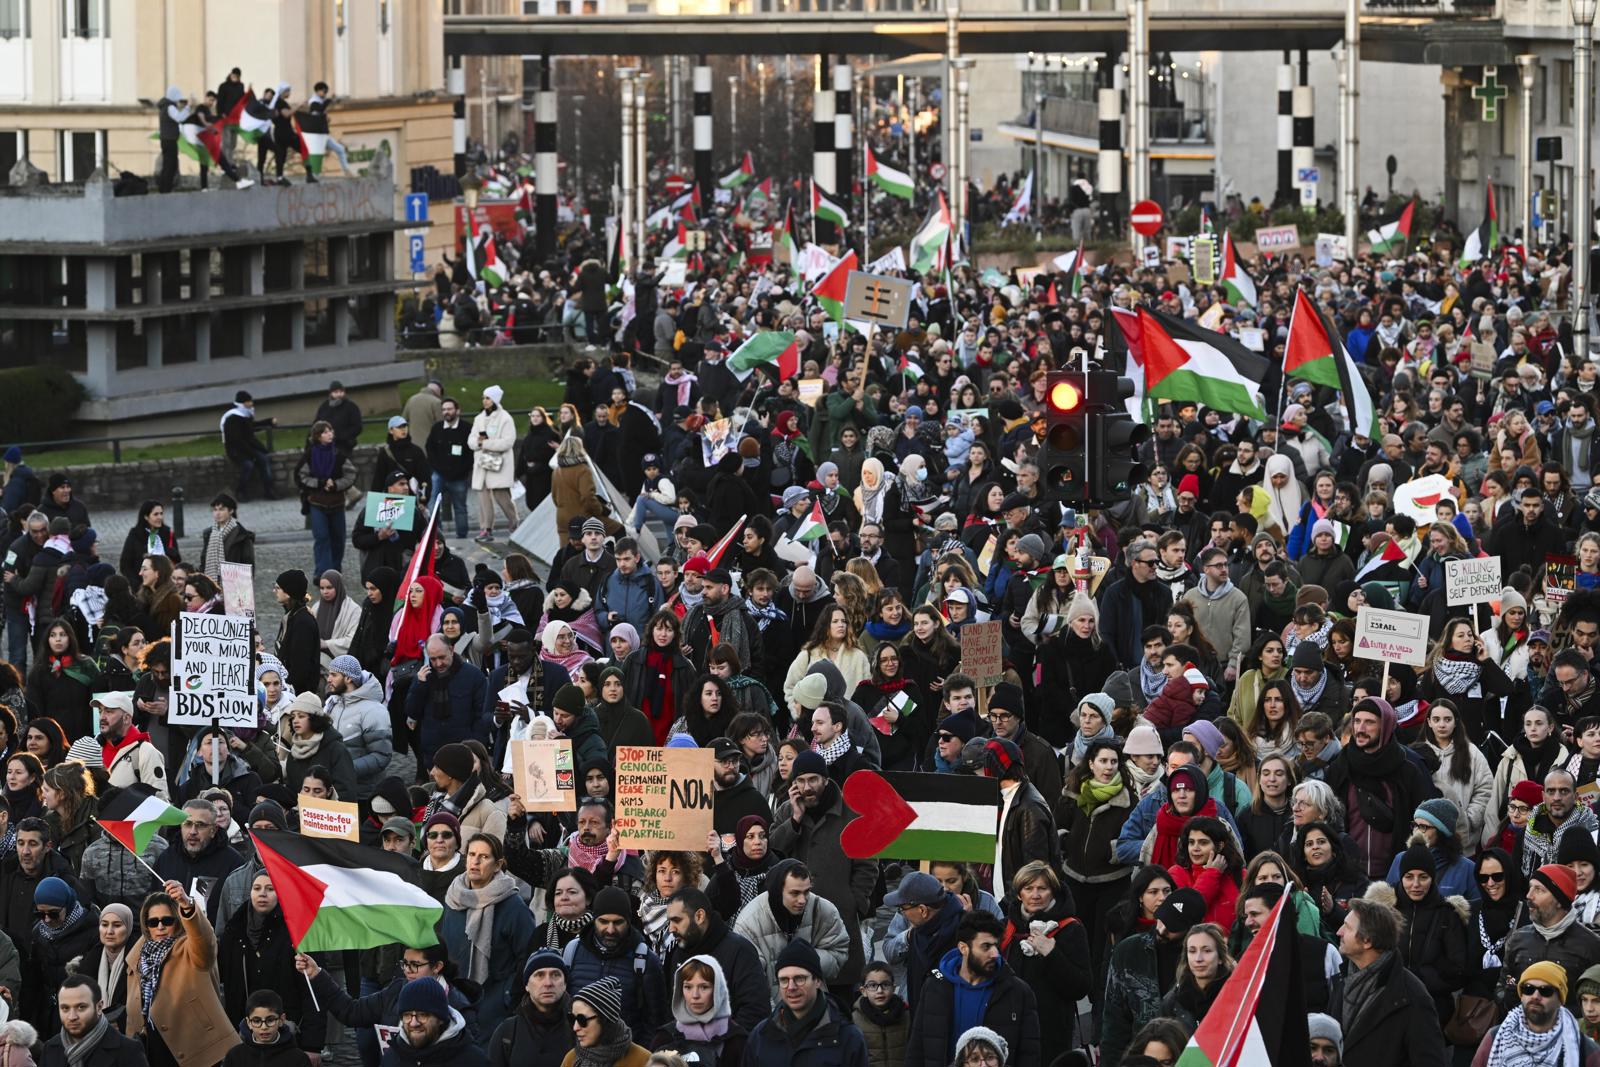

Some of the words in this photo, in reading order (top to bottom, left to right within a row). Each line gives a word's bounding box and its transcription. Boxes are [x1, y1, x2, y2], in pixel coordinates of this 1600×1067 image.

[1448, 563, 1458, 577] IS
[1462, 561, 1495, 575] KILLING
[1454, 572, 1495, 586] CHILDREN
[1449, 587, 1468, 599] SELF
[183, 617, 250, 637] DECOLONIZE
[962, 624, 982, 636] LAND
[987, 622, 1000, 634] YOU
[1370, 622, 1396, 631] ISRAEL
[962, 637, 981, 647] HAVE
[988, 634, 998, 644] TO
[1370, 640, 1387, 650] ENTER
[1389, 643, 1395, 651] A
[1396, 644, 1413, 653] VALID
[185, 641, 212, 655] YOUR
[962, 645, 997, 656] COMMIT
[1382, 650, 1402, 659] STATE
[963, 655, 1000, 667] GENOCIDE
[185, 661, 207, 674] AND
[987, 666, 994, 675] IS
[176, 692, 215, 718] BDS
[219, 700, 253, 716] NOW
[619, 748, 645, 762] STOP
[646, 749, 664, 762] THE
[620, 762, 667, 772] GENOCIDE
[618, 774, 668, 785] PERMANENT
[618, 785, 644, 794] CEASE
[645, 786, 666, 795] FIRE
[670, 779, 714, 810] NOW
[619, 797, 643, 806] ARMS
[303, 809, 351, 824] Cessez-le-feu
[624, 808, 667, 818] EMBARGO
[303, 820, 342, 833] maintenant
[617, 818, 637, 827] END
[640, 819, 661, 829] THE
[620, 829, 675, 840] APARTHEID
